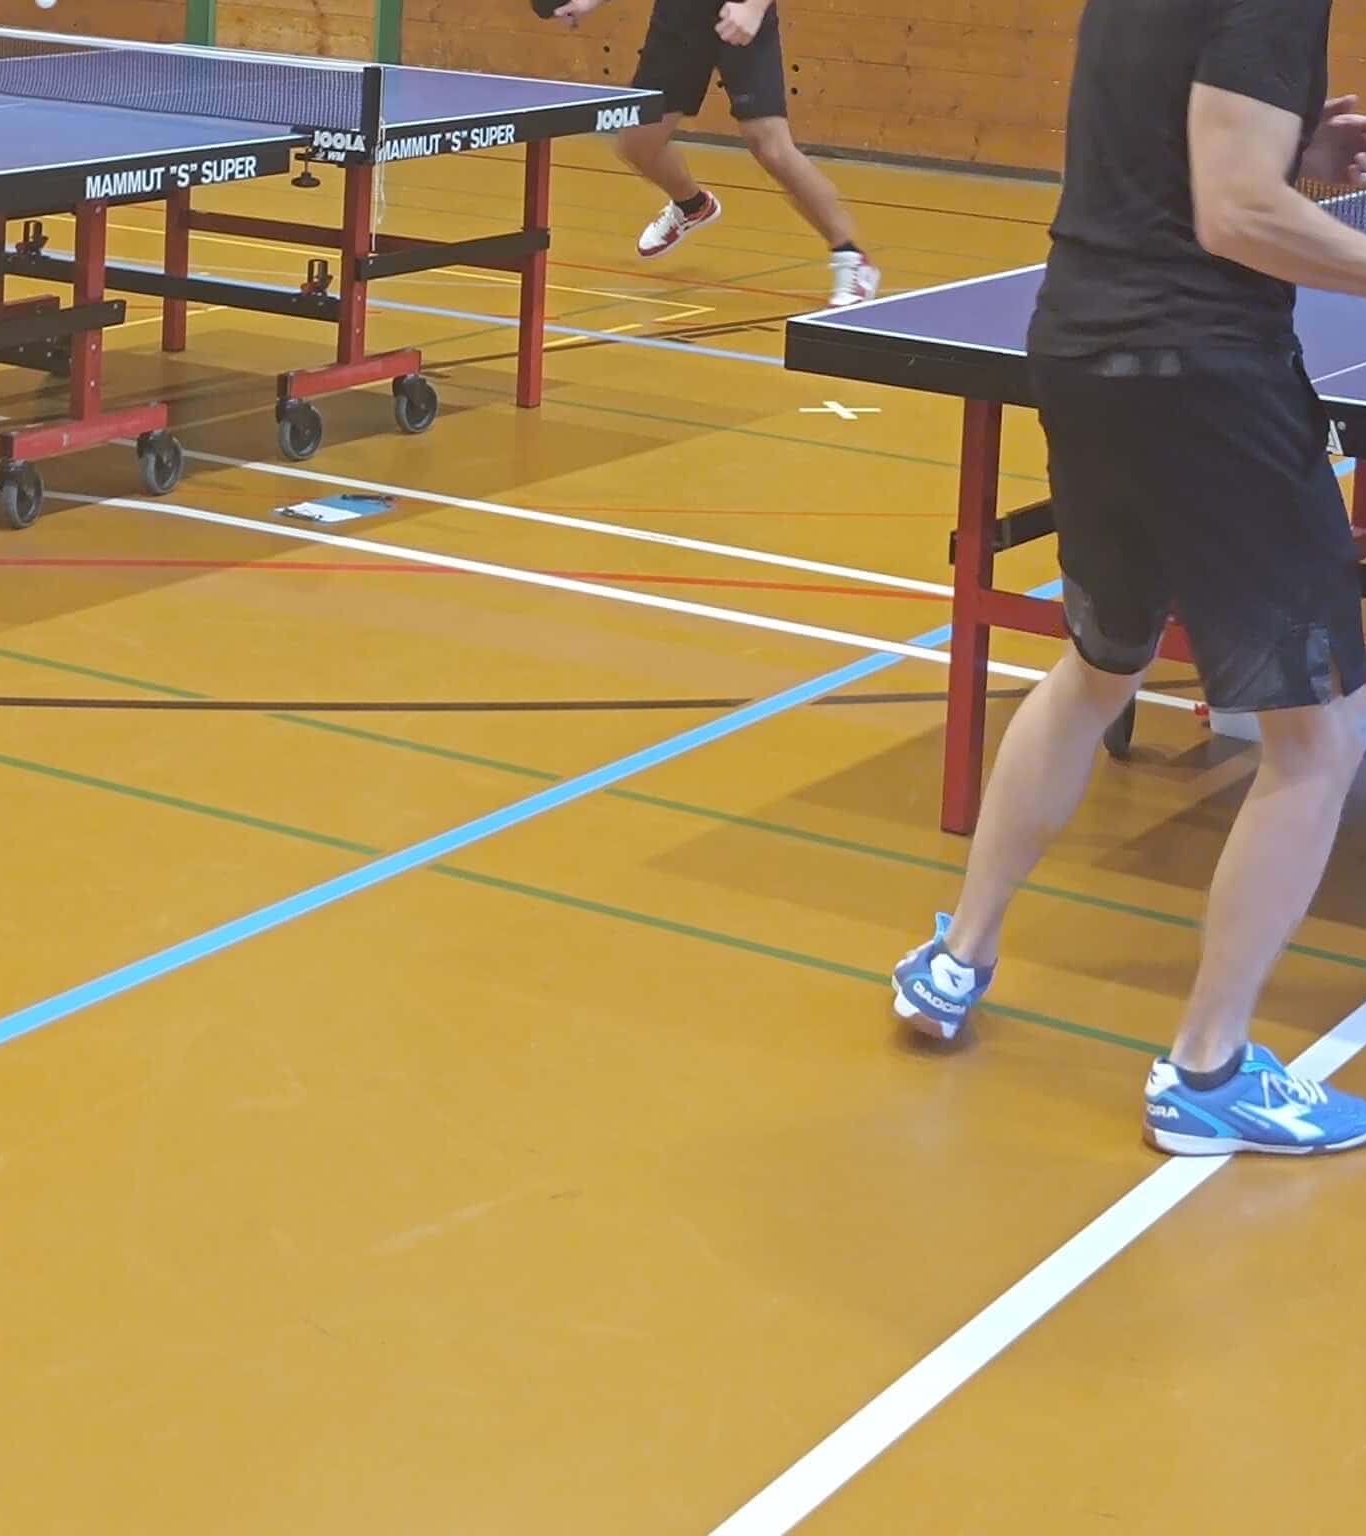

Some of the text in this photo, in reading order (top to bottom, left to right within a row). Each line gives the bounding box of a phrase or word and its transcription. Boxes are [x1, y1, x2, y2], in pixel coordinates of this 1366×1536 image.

[596, 105, 640, 131] JOOLA
[313, 130, 365, 152] JOOLA
[379, 134, 442, 162] MAMMUT
[470, 124, 515, 148] SUPER
[86, 167, 165, 199] MAMMUT
[201, 156, 256, 183] SUPER
